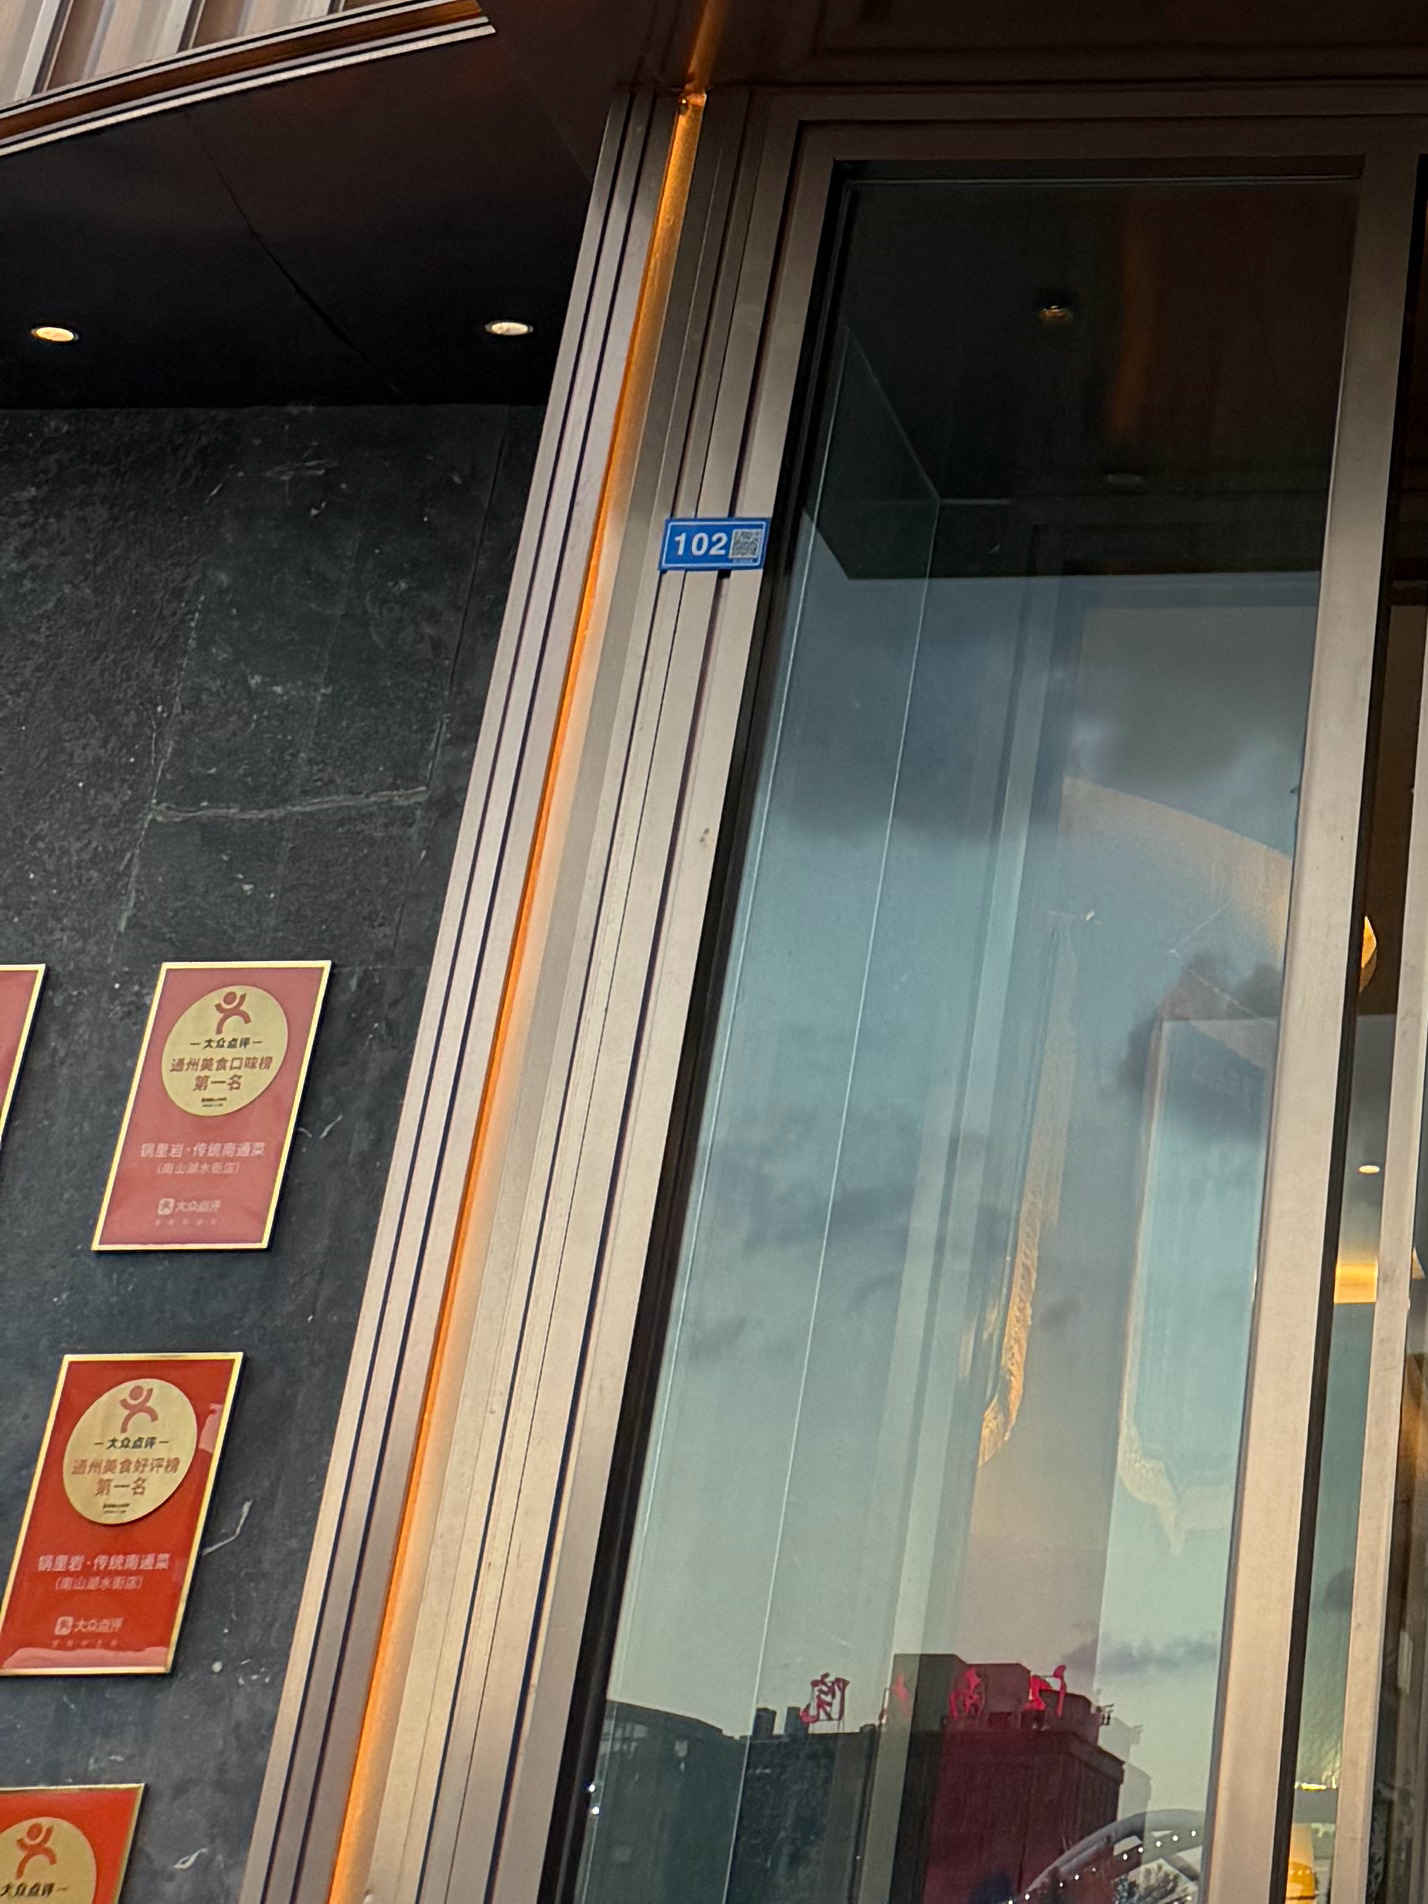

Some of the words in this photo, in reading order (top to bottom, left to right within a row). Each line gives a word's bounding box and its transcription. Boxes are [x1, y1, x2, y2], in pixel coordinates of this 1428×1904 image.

[674, 532, 728, 556] 102
[203, 1037, 251, 1049] 大众点评
[170, 1056, 274, 1072] 通州美食口味榜
[193, 1074, 243, 1092] 第一名
[106, 1436, 157, 1450] 大众点评
[71, 1456, 181, 1475] 通州美食好评榜
[95, 1477, 148, 1497] 第一名
